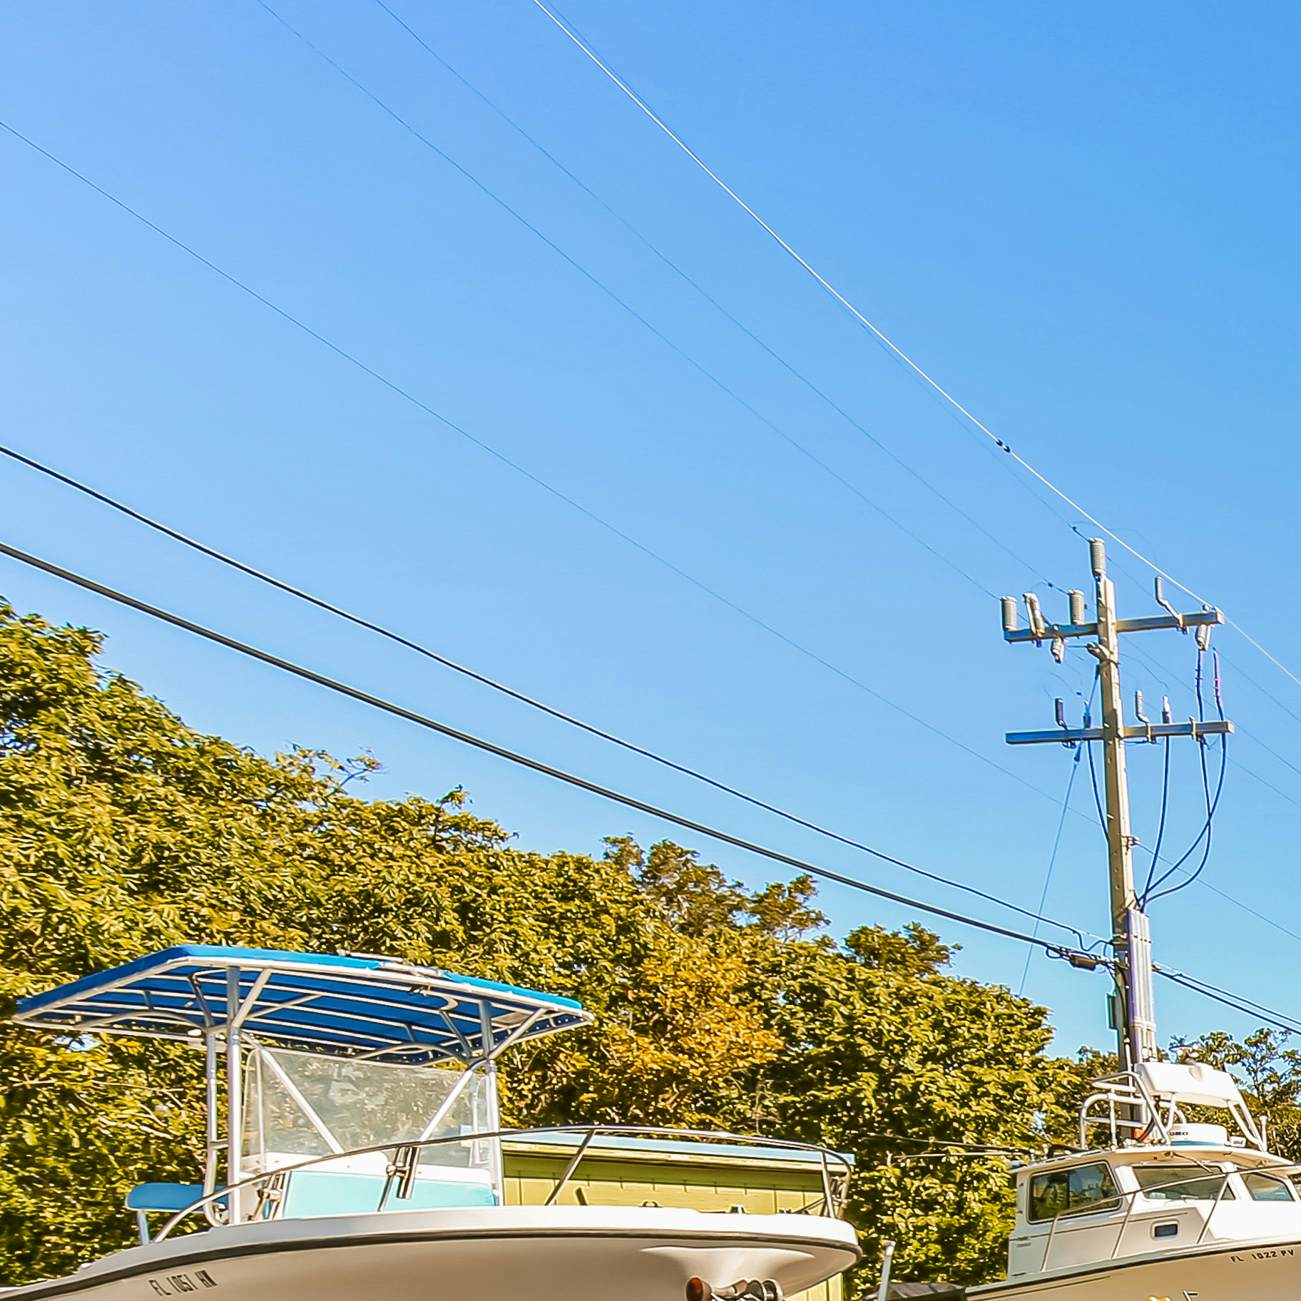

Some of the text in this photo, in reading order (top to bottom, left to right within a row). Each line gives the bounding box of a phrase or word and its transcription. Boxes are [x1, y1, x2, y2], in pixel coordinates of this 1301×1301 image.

[1230, 1255, 1245, 1263] FL
[1280, 1248, 1295, 1257] PV
[148, 1279, 172, 1297] FL
